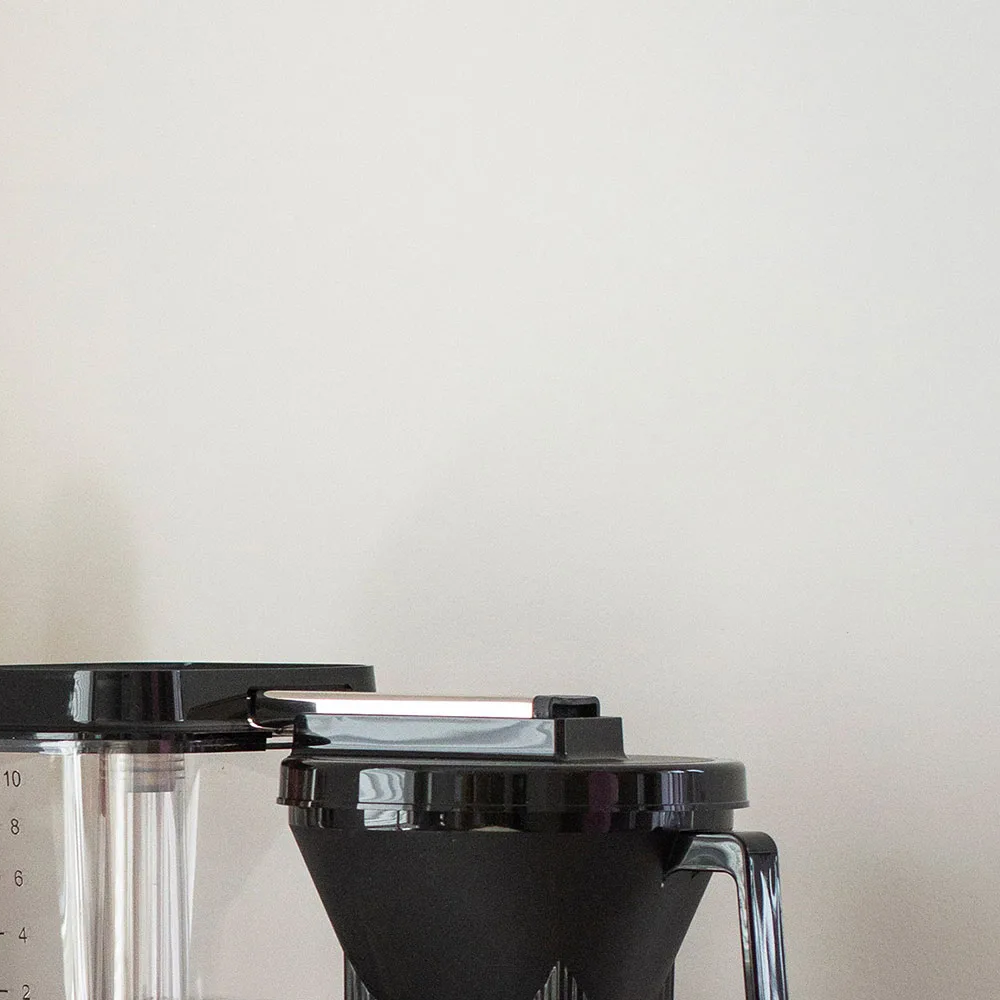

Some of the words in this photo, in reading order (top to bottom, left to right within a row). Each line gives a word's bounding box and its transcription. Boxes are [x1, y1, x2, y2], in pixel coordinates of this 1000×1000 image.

[3, 770, 21, 788] 10
[10, 818, 20, 835] 8
[14, 870, 23, 887] 6
[18, 927, 28, 943] 4
[21, 984, 31, 1000] 2
